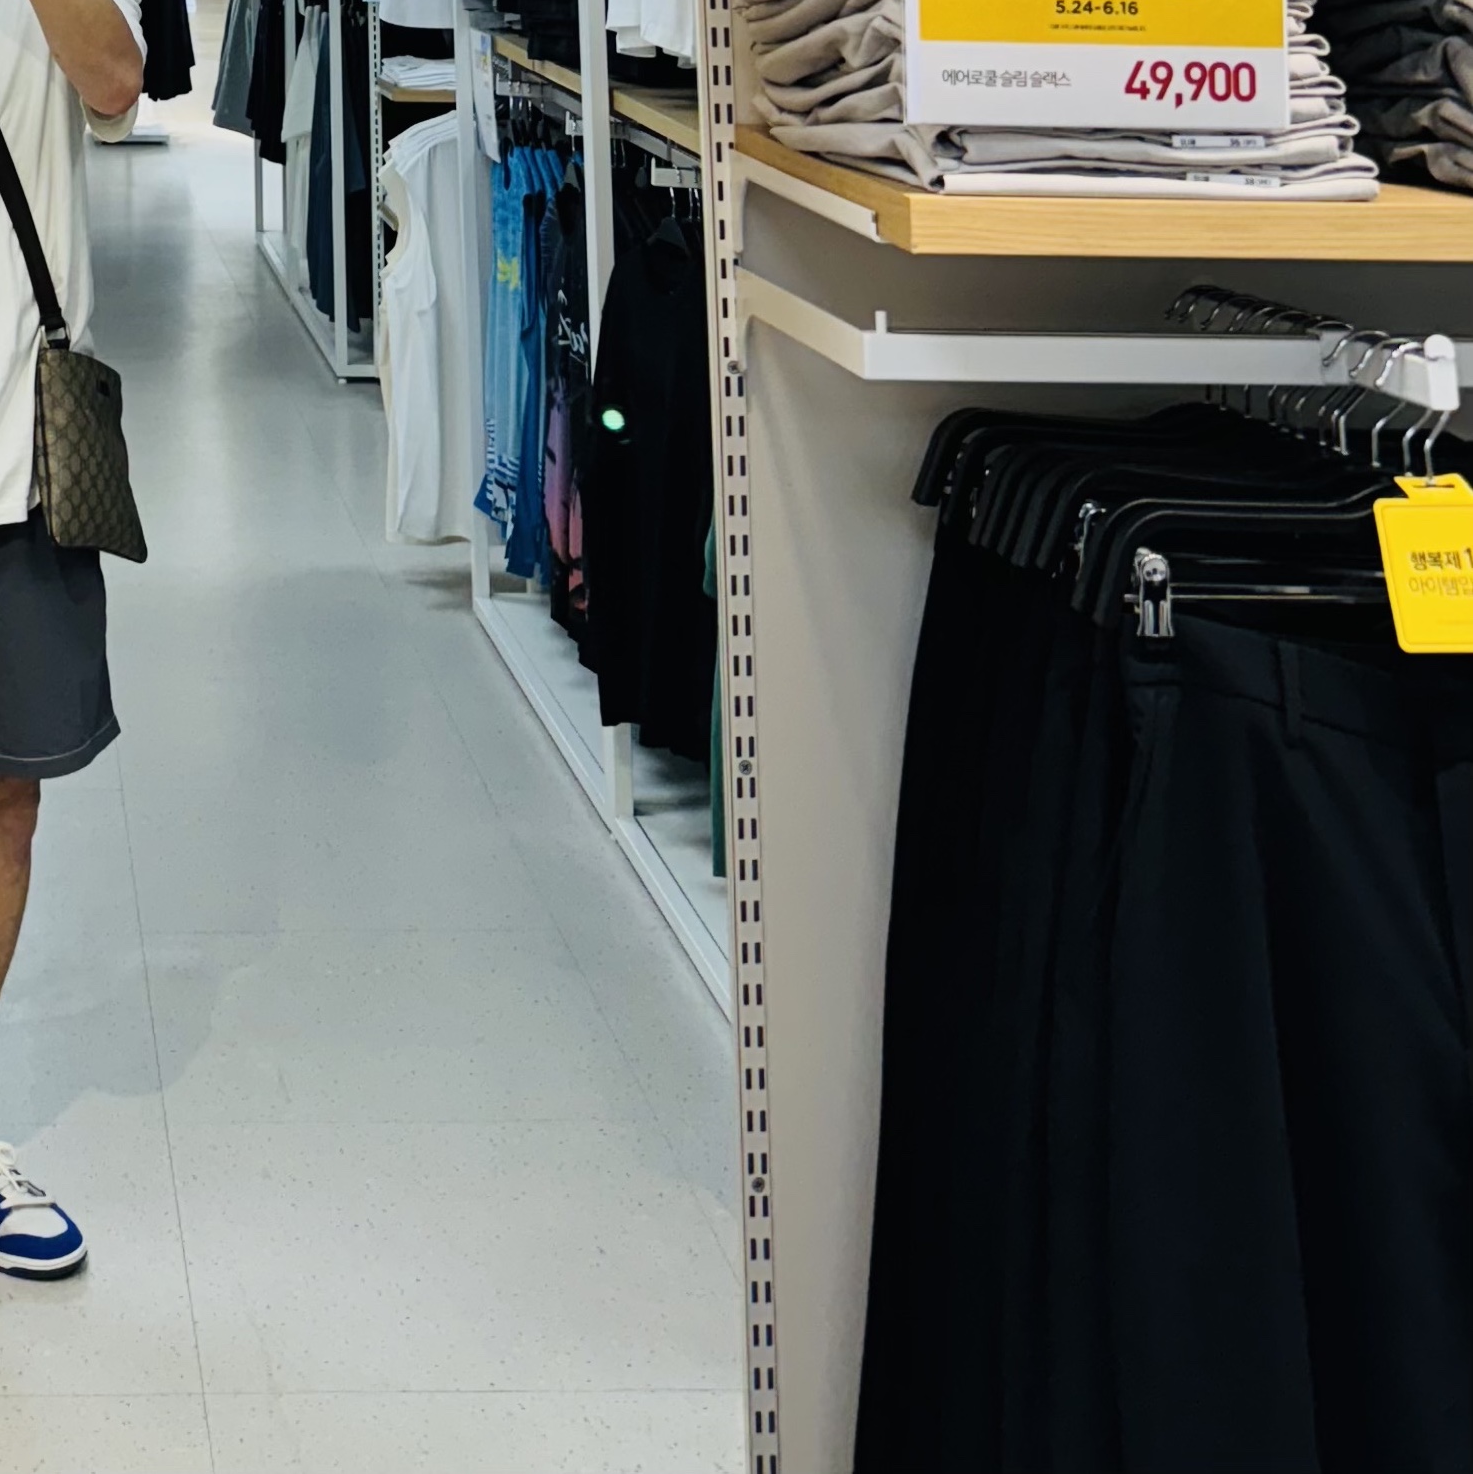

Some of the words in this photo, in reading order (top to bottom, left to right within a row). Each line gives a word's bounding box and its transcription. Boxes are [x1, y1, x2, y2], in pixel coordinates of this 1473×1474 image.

[1055, 0, 1139, 16] 5.24-6.16
[941, 68, 999, 88] 에어로쿨
[1000, 69, 1028, 88] 슬림
[1029, 70, 1072, 89] 슬랙스
[1124, 60, 1257, 110] 49,900
[1410, 551, 1461, 571] 행복제
